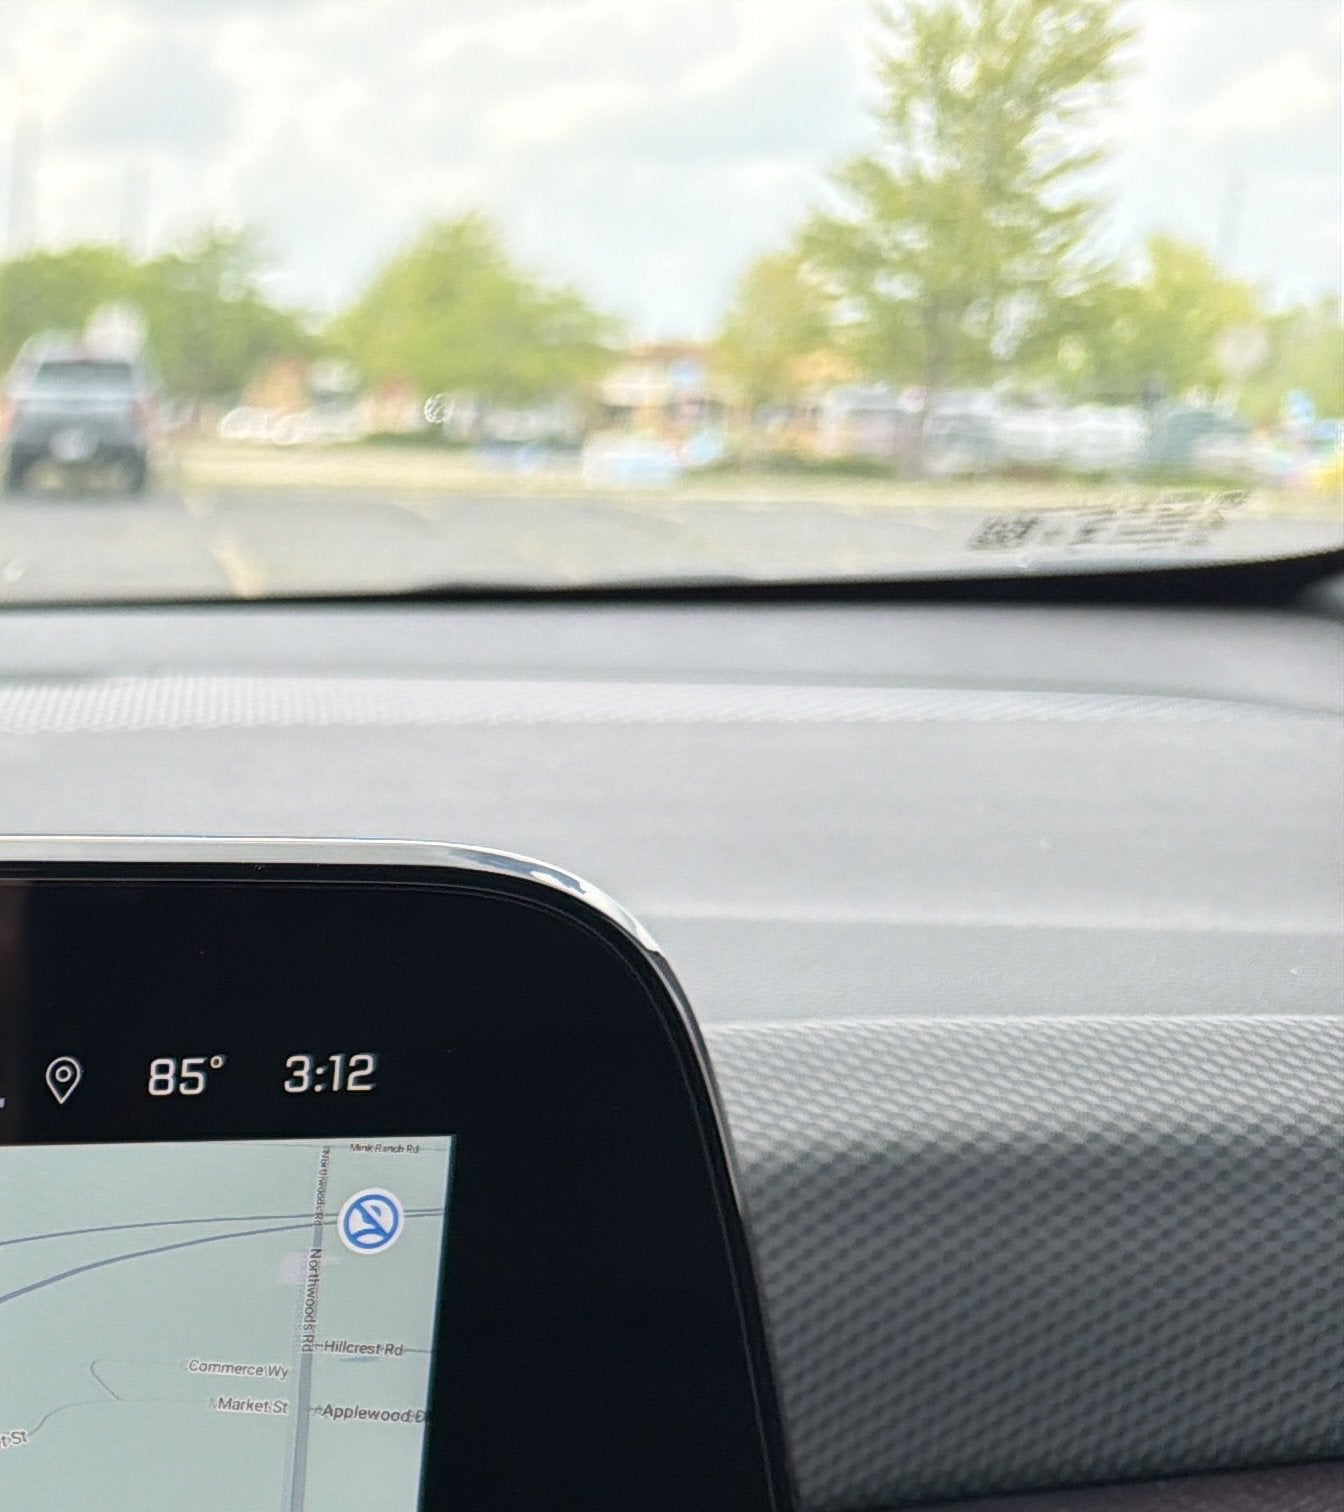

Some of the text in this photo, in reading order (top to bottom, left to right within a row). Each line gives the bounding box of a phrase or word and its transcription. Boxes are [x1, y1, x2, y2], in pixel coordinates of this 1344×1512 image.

[284, 1054, 375, 1093] 3:12
[406, 1145, 419, 1153] Rd
[314, 1211, 324, 1226] Rd
[301, 1249, 322, 1352] Northwoods Rd
[324, 1340, 403, 1356] Hillcrest Rd
[189, 1360, 289, 1380] Commerce Wy
[218, 1397, 288, 1414] Market St
[321, 1403, 410, 1422] Applewood
[10, 1430, 28, 1443] St
